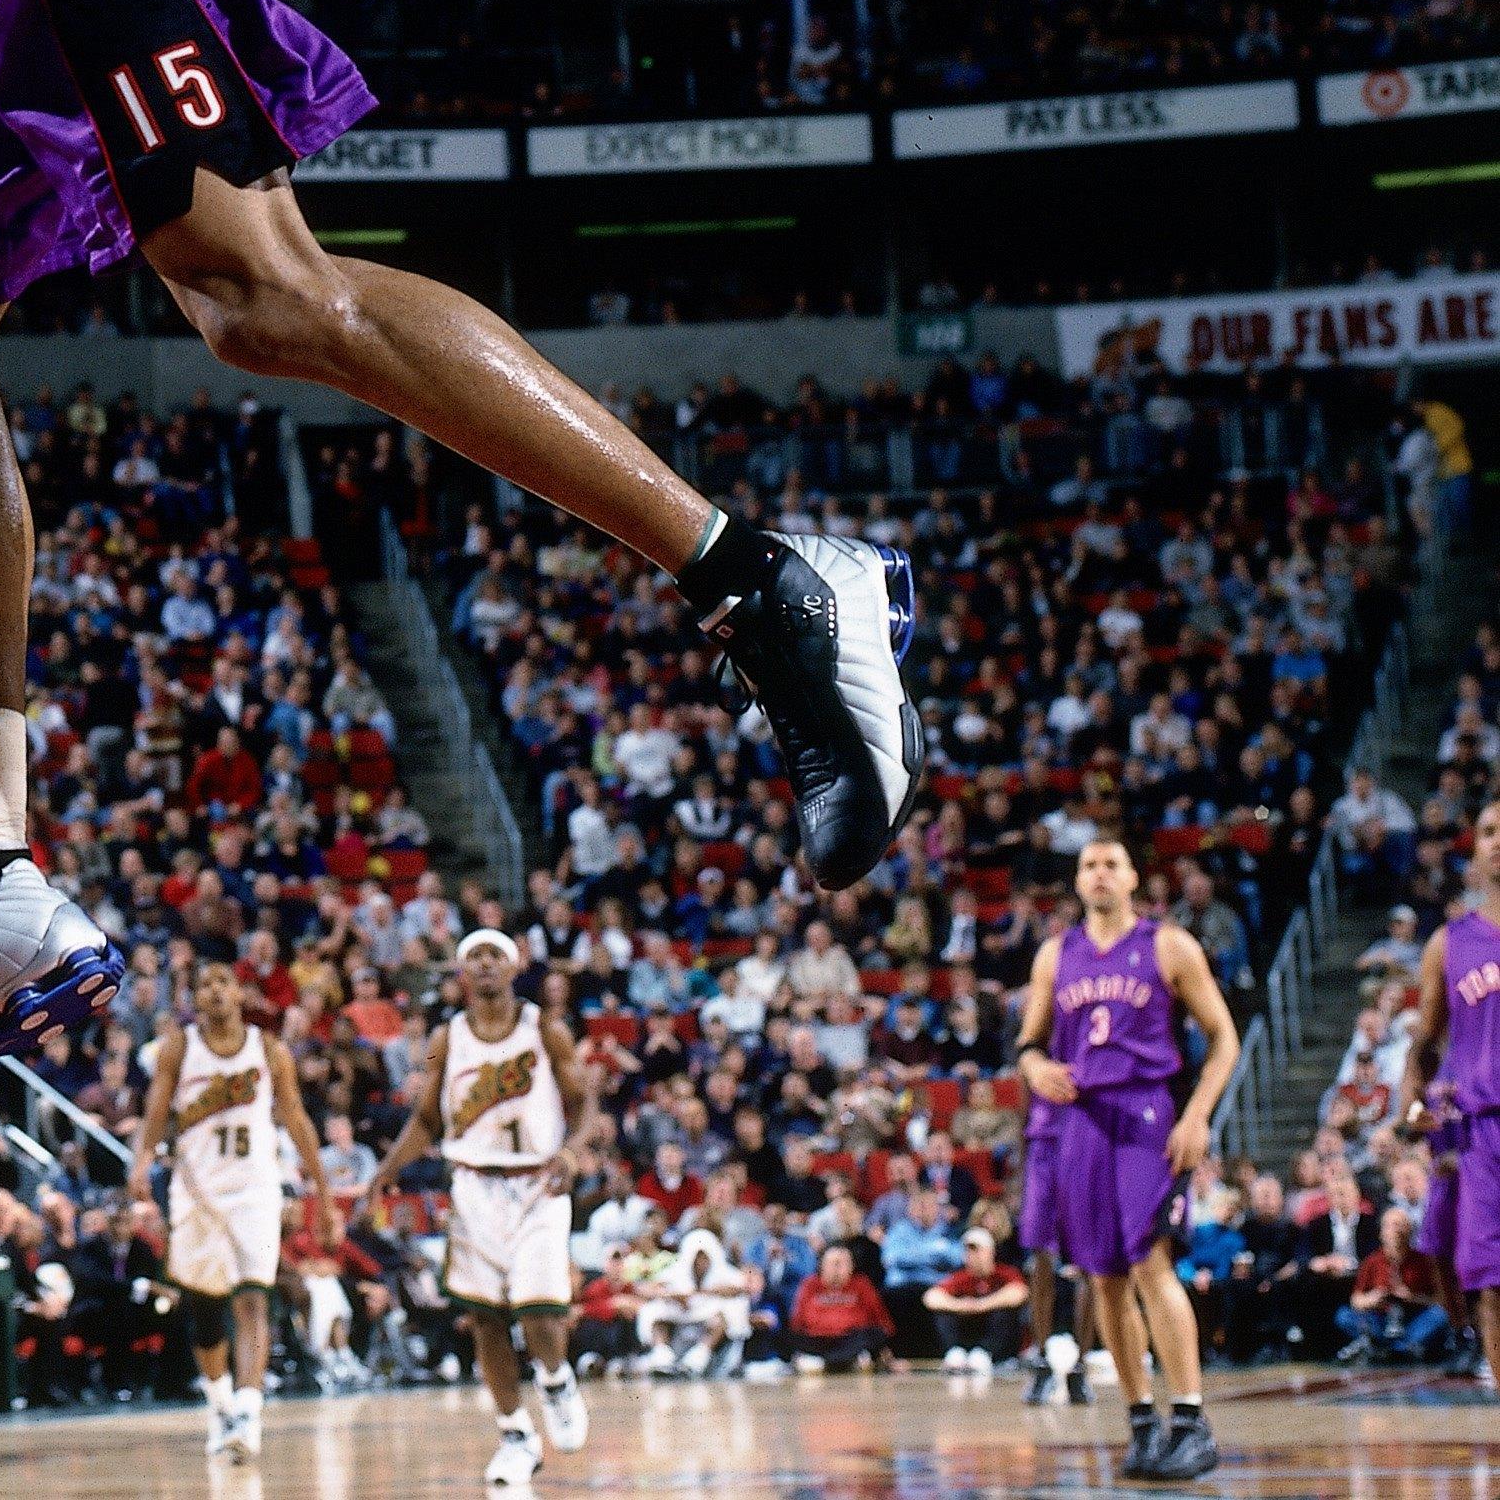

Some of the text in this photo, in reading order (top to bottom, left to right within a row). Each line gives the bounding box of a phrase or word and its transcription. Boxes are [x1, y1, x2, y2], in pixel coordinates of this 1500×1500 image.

[107, 39, 226, 156] 15
[1007, 94, 1168, 138] PAY LESS
[1191, 291, 1496, 361] OUR FANS ARE
[1087, 1004, 1111, 1047] 3
[501, 1118, 522, 1154] 1
